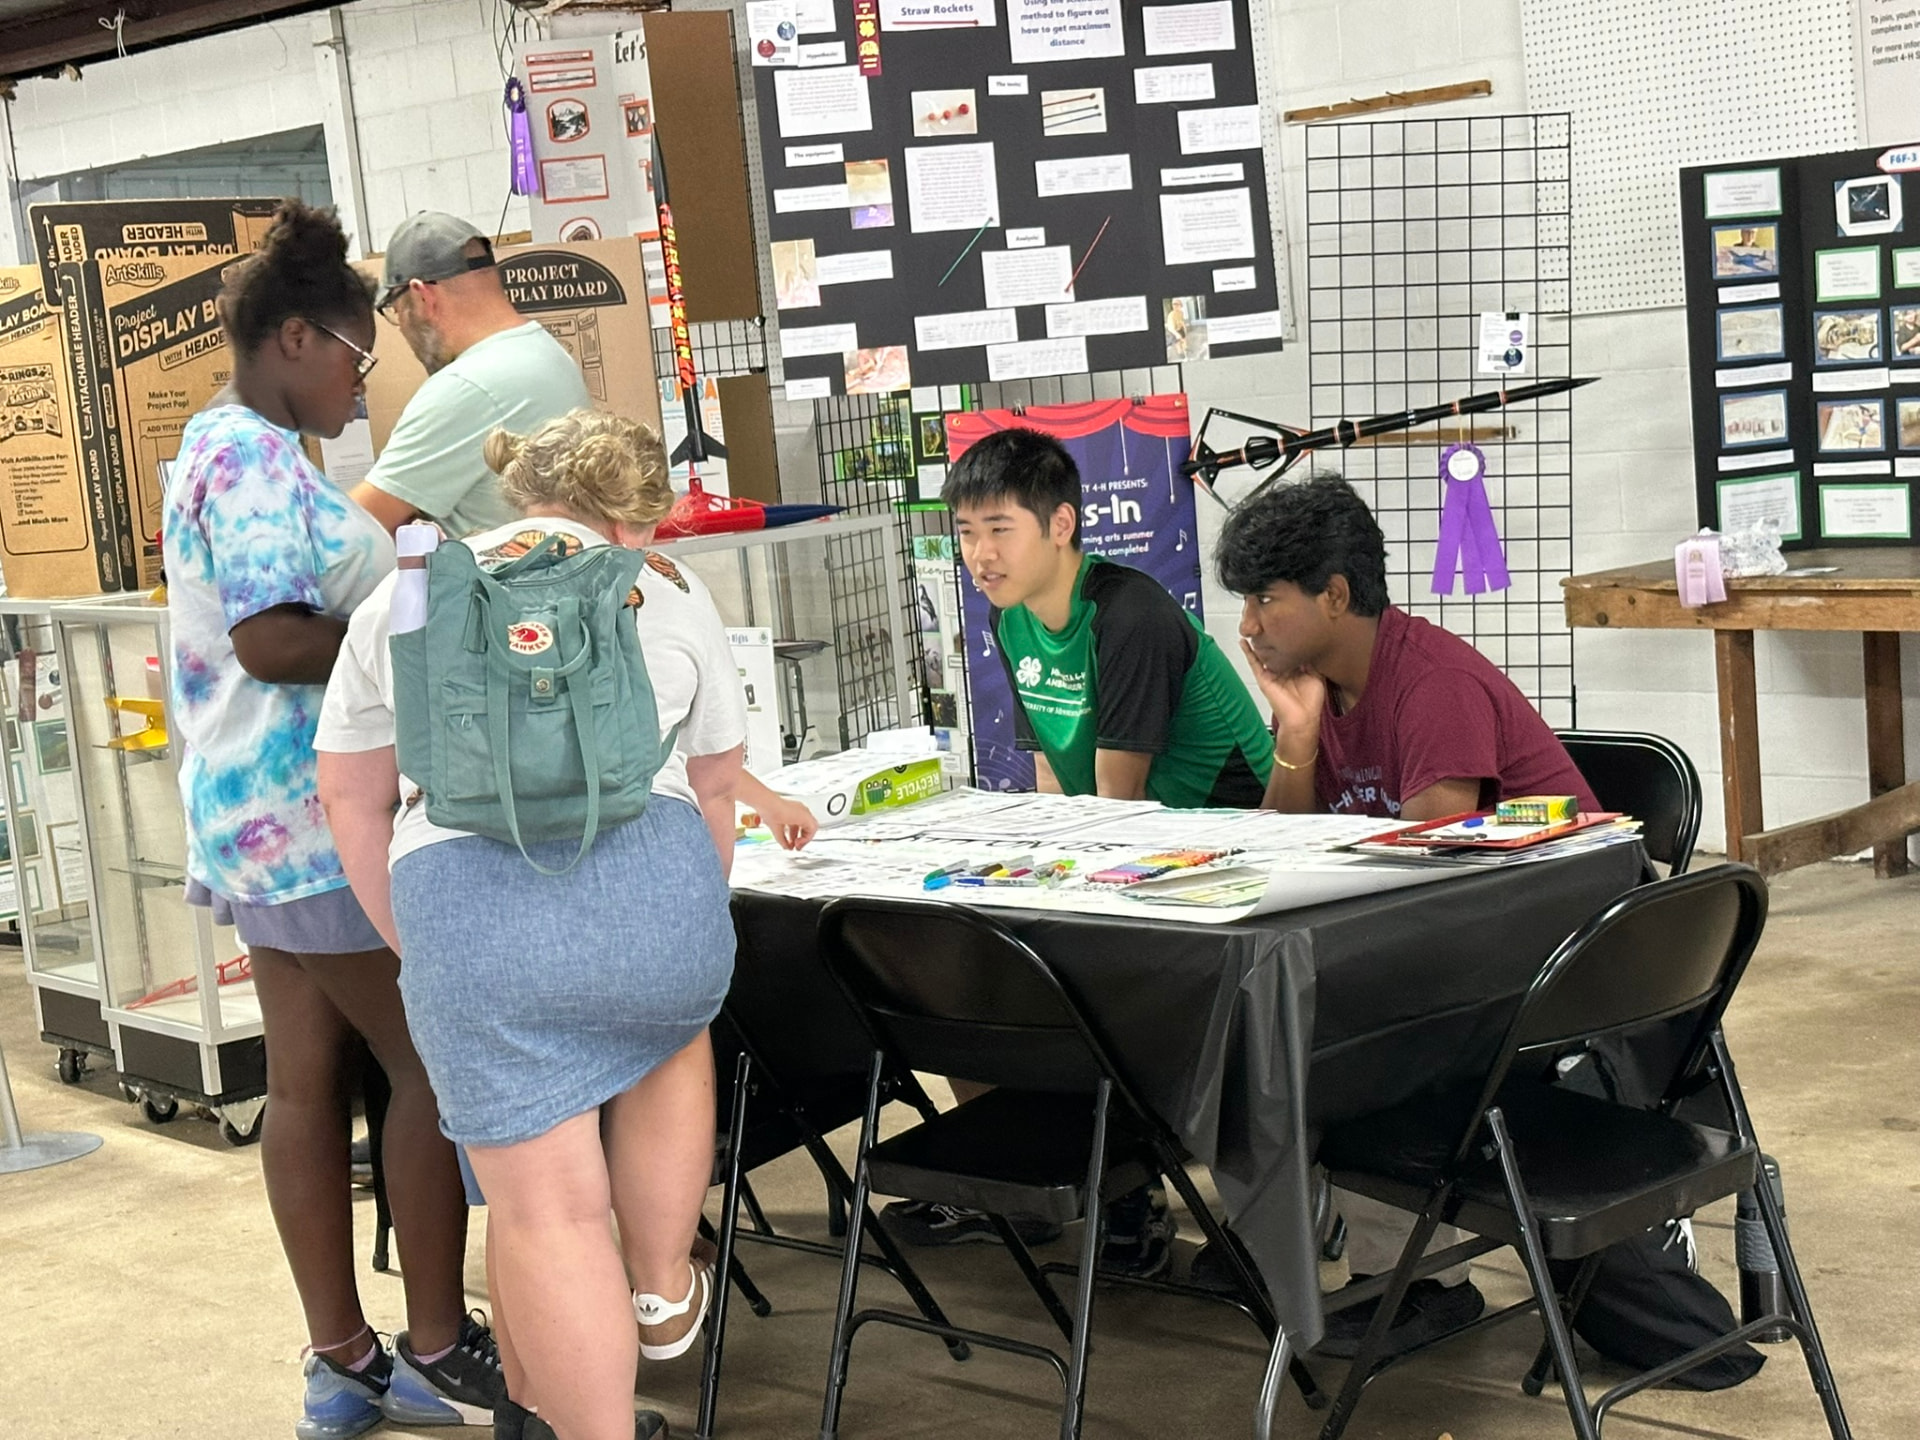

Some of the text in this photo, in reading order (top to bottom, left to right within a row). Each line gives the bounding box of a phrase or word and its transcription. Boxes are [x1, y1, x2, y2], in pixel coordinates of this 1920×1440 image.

[901, 4, 974, 16] Straw Rockets
[1020, 11, 1053, 20] method
[1067, 9, 1092, 19] figure
[1871, 9, 1916, 24] To join, youth
[1053, 25, 1067, 34] get
[1069, 23, 1111, 31] maximum
[1871, 24, 1902, 35] complete
[615, 34, 646, 64] Let's
[1050, 38, 1085, 47] distance
[1872, 46, 1883, 54] For
[1884, 44, 1902, 52] more
[1873, 53, 1914, 66] contact 4-H
[1890, 153, 1917, 164] F6F-3
[127, 225, 184, 240] HEADER
[47, 245, 56, 260] in.
[106, 262, 165, 283] ArtSkills
[505, 264, 579, 284] PROJECT
[504, 280, 608, 303] PLAY BOARD
[0, 312, 19, 331] LAY
[68, 295, 82, 341] HEADER
[115, 304, 157, 332] Project
[11, 323, 41, 340] HEADER
[119, 305, 198, 357] DISPLAY
[164, 349, 183, 365] WITH
[9, 367, 38, 381] RINGS
[74, 342, 92, 415] ATTACHABLE
[148, 390, 186, 399] Make Your
[147, 399, 189, 410] Project Pop!
[109, 433, 120, 466] BOARD
[89, 449, 99, 481] BOARD
[114, 466, 124, 504] DISPLAY
[1092, 483, 1107, 492] 4-H
[1108, 478, 1148, 490] PRESENTS:
[93, 481, 105, 519] DISPLAY
[1081, 493, 1142, 527] s-In
[1105, 533, 1120, 542] arts
[1123, 530, 1154, 540] summer
[1108, 542, 1149, 557] completed
[509, 640, 547, 652] ANKEN
[896, 772, 940, 801] RECYCLE
